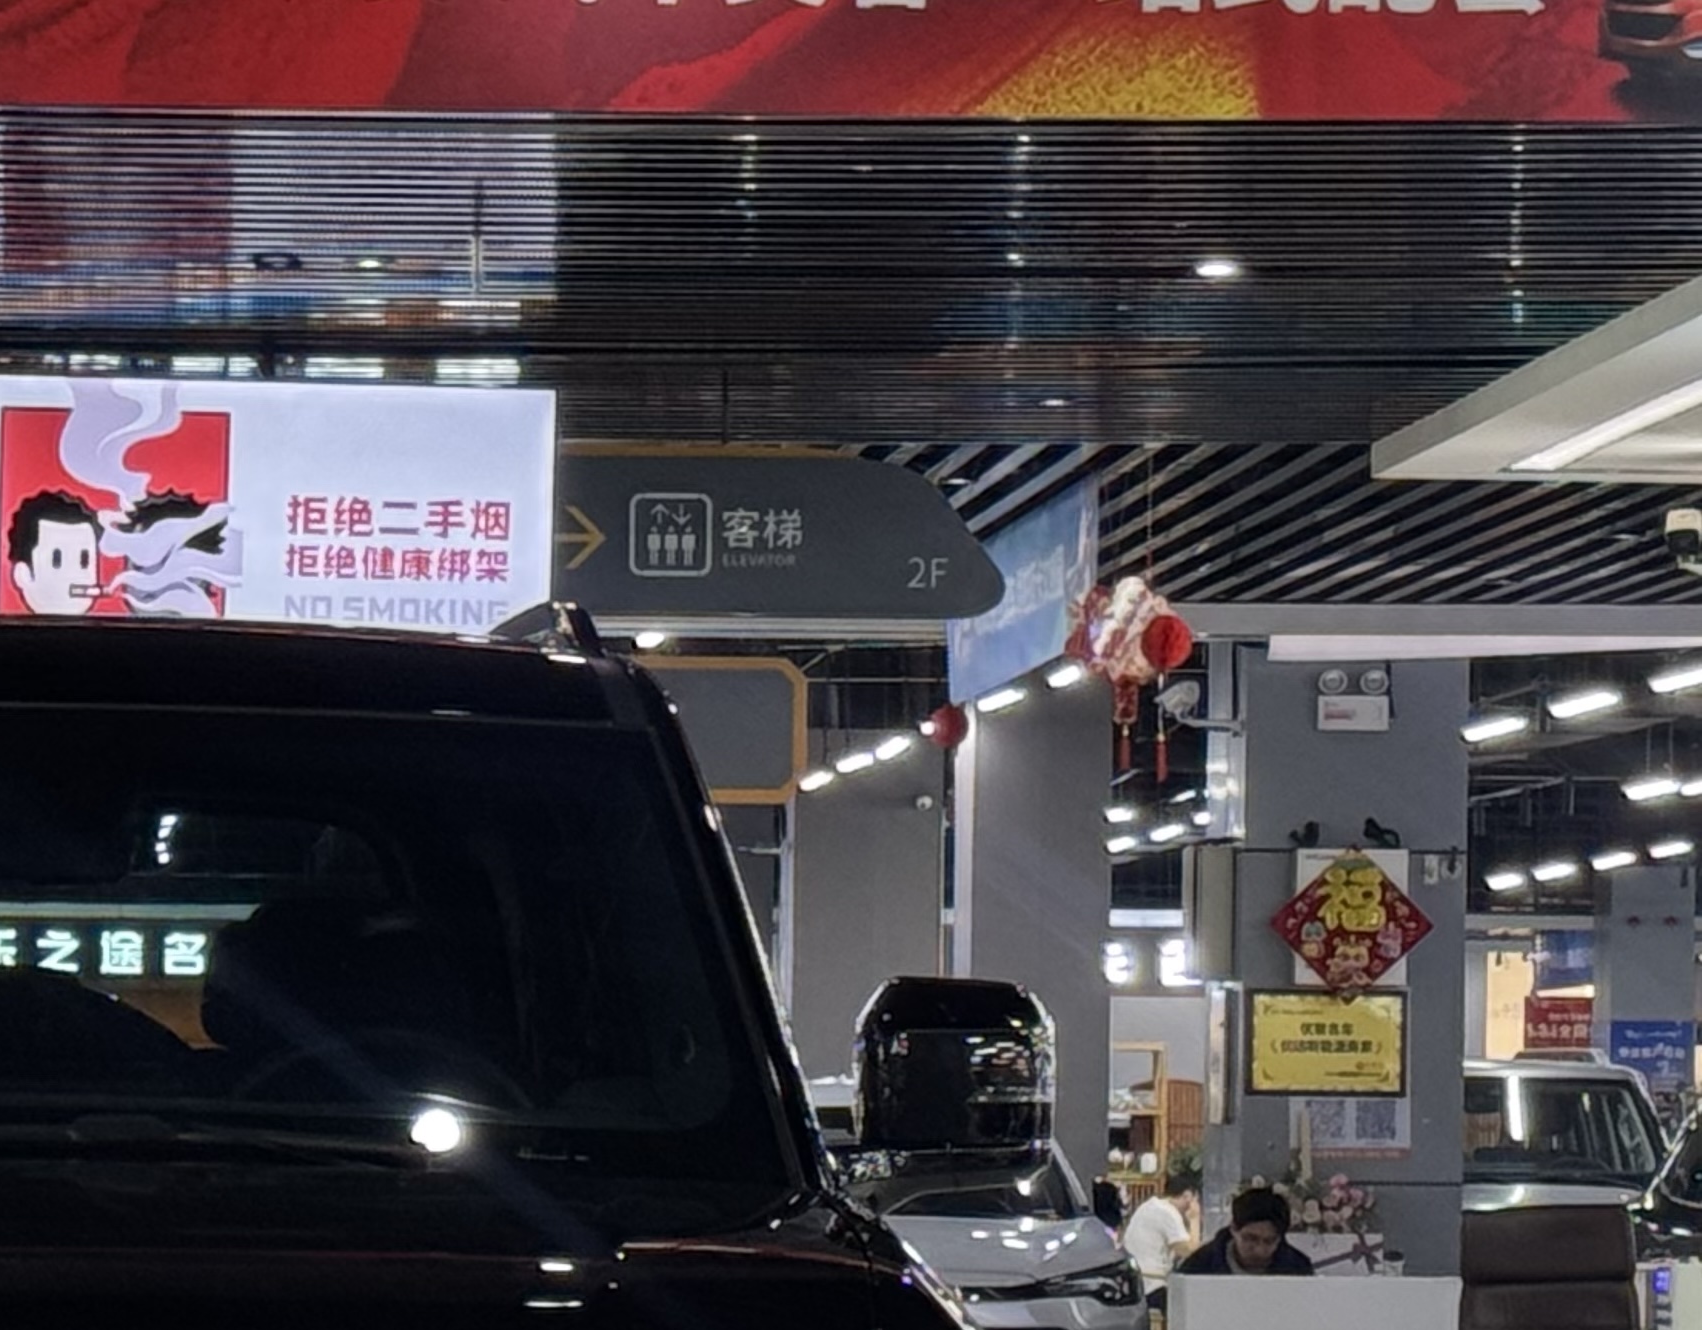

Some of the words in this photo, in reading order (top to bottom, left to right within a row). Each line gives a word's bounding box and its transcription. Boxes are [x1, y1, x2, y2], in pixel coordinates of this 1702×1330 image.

[287, 494, 511, 541] 拒绝二手烟
[722, 507, 804, 550] 客梯
[284, 544, 511, 584] 拒绝健康绑架
[722, 553, 796, 568] ELEVATOR
[907, 557, 950, 590] 2F
[284, 595, 333, 620] NO
[342, 596, 511, 626] SMOKING
